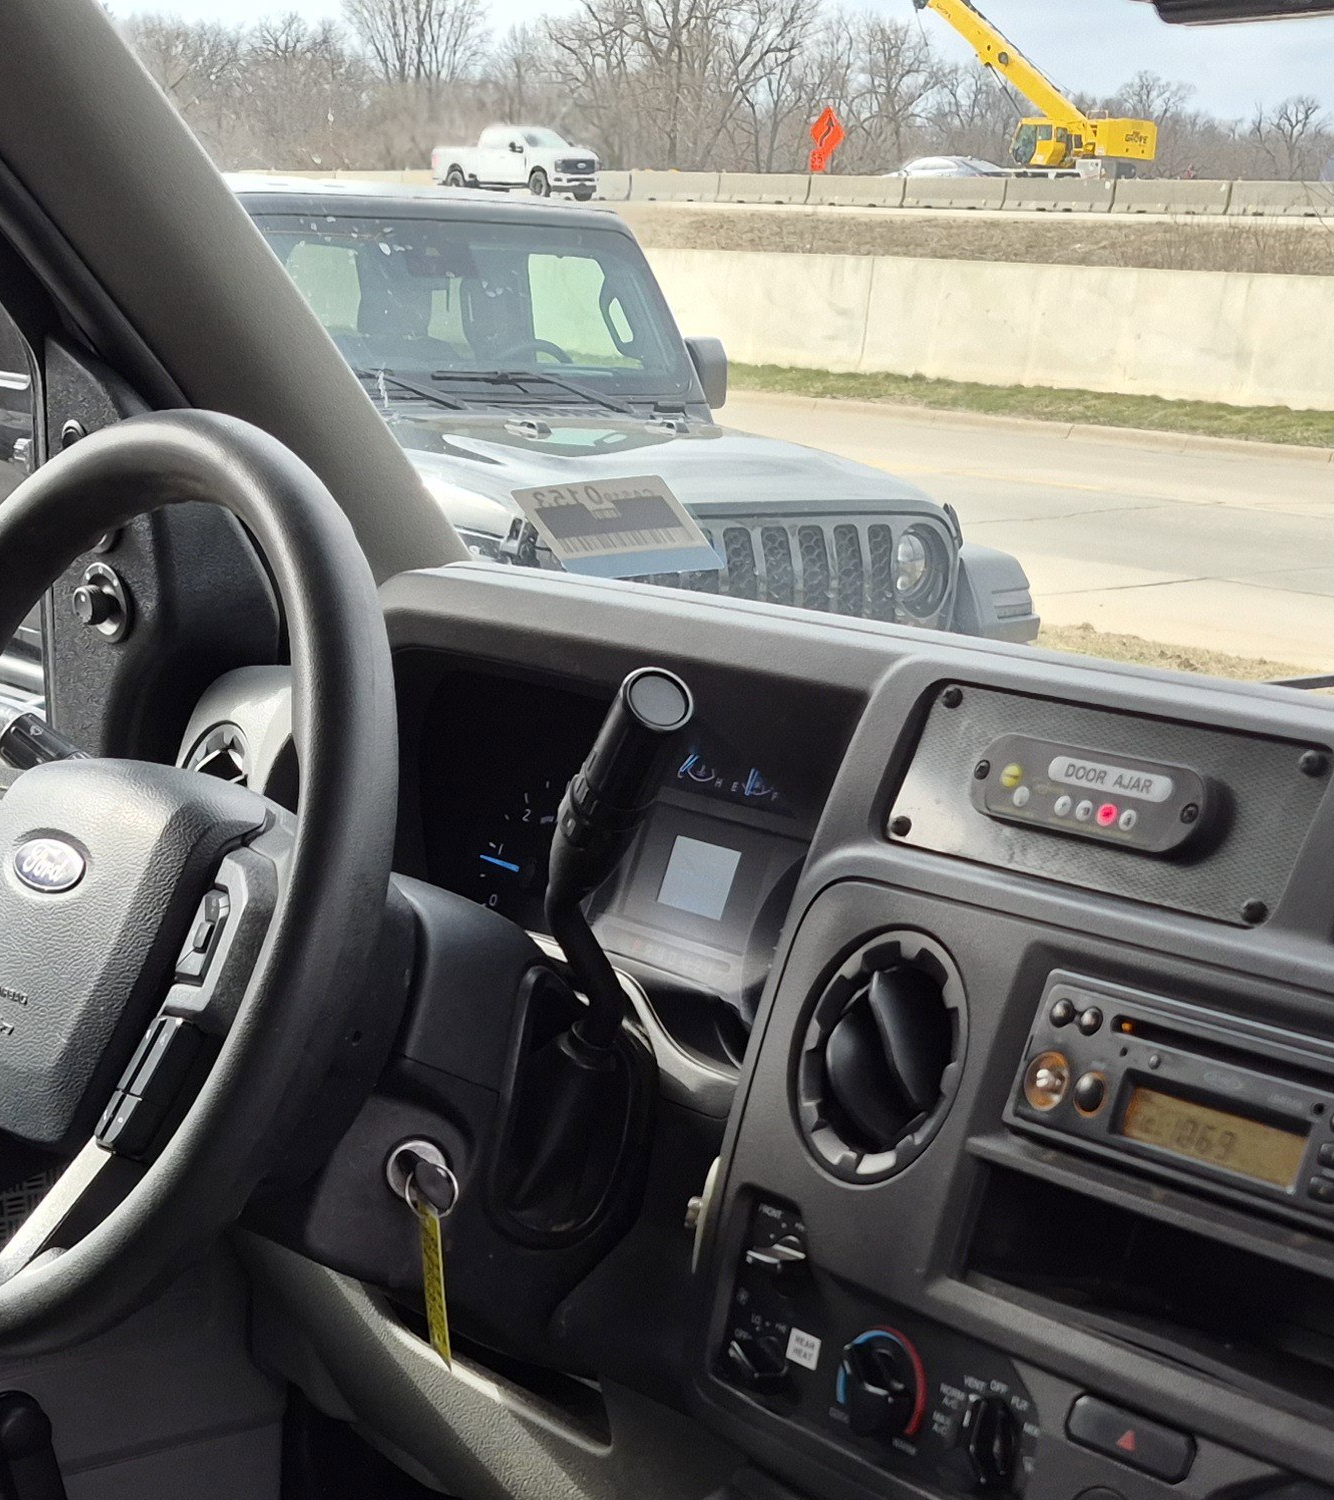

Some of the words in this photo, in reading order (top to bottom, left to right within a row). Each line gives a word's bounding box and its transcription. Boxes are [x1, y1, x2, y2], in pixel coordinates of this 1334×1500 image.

[1064, 762, 1107, 785] DOOR
[1112, 774, 1154, 794] AJAR
[522, 808, 531, 822] 2
